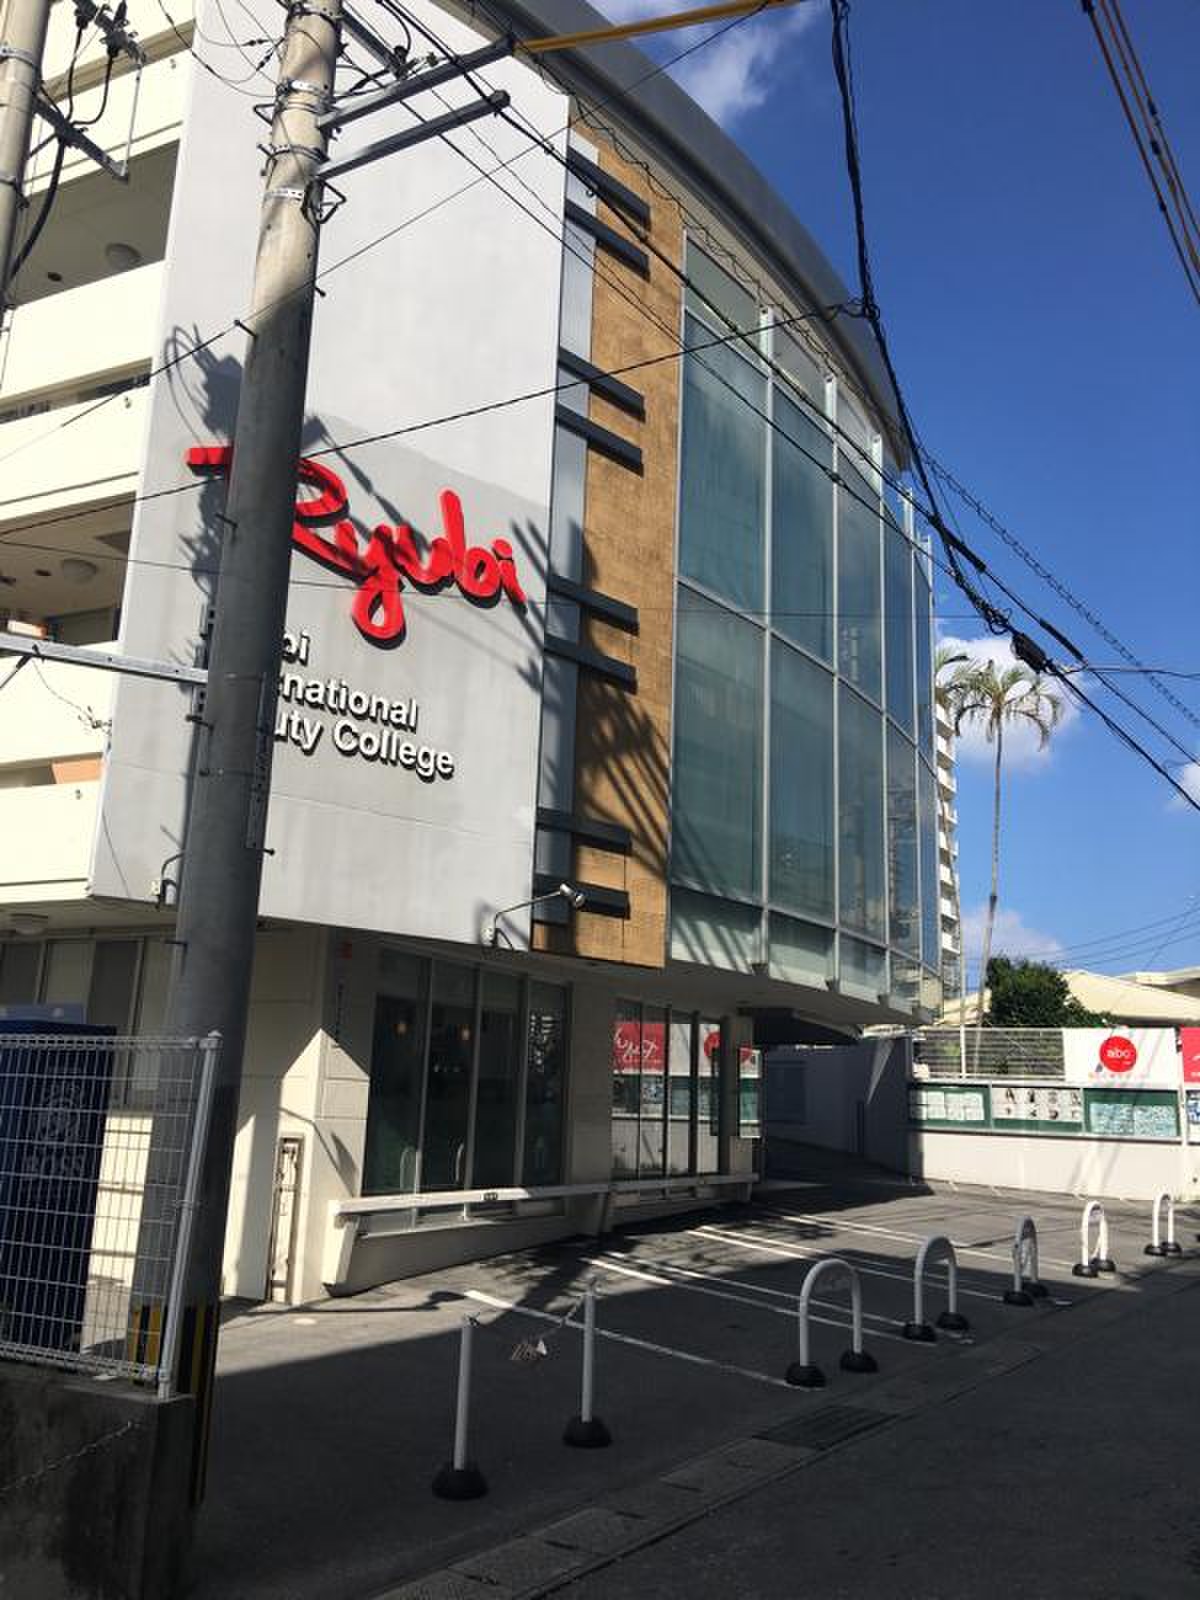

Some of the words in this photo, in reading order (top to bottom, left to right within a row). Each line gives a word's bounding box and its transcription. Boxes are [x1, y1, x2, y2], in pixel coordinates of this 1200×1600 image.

[186, 444, 526, 638] Ryubi
[279, 672, 418, 729] national
[333, 719, 454, 778] College
